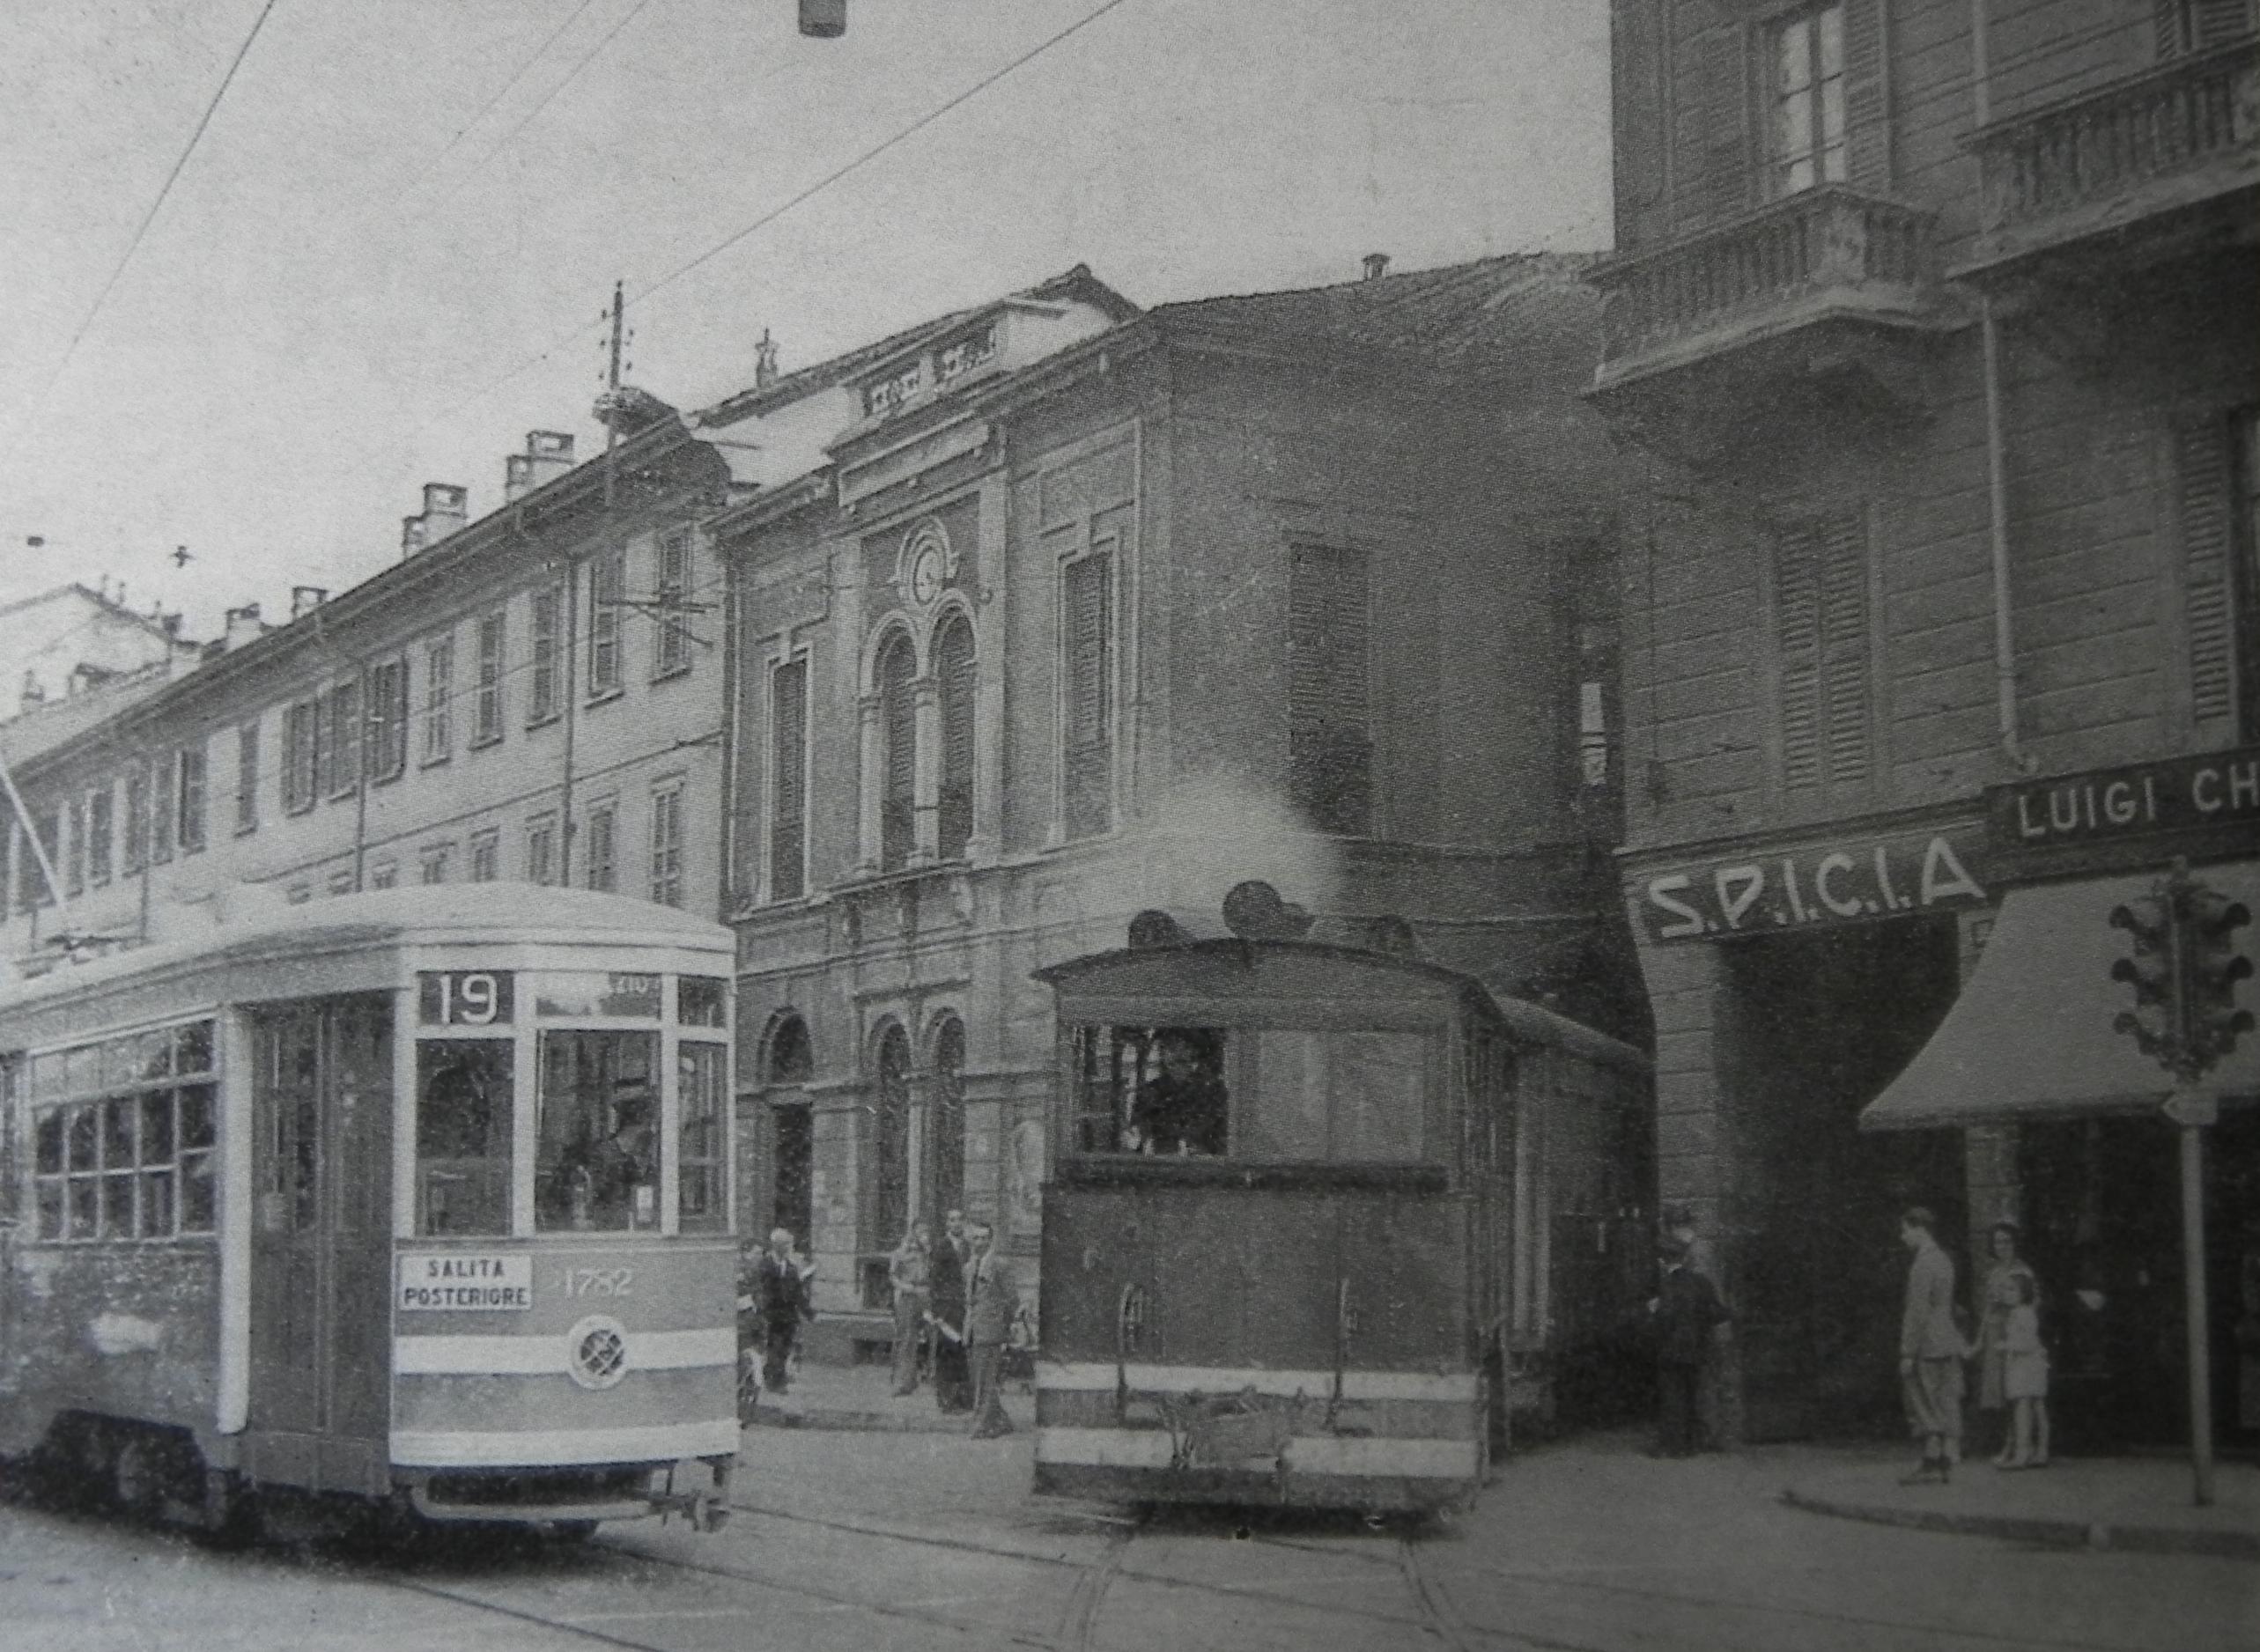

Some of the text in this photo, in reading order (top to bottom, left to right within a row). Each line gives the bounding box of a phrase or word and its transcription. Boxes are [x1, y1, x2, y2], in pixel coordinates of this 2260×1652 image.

[2018, 761, 2260, 837] LUIGI CH
[439, 973, 499, 1024] 19
[427, 1258, 505, 1278] SALITA
[403, 1286, 528, 1306] POSTERIORE
